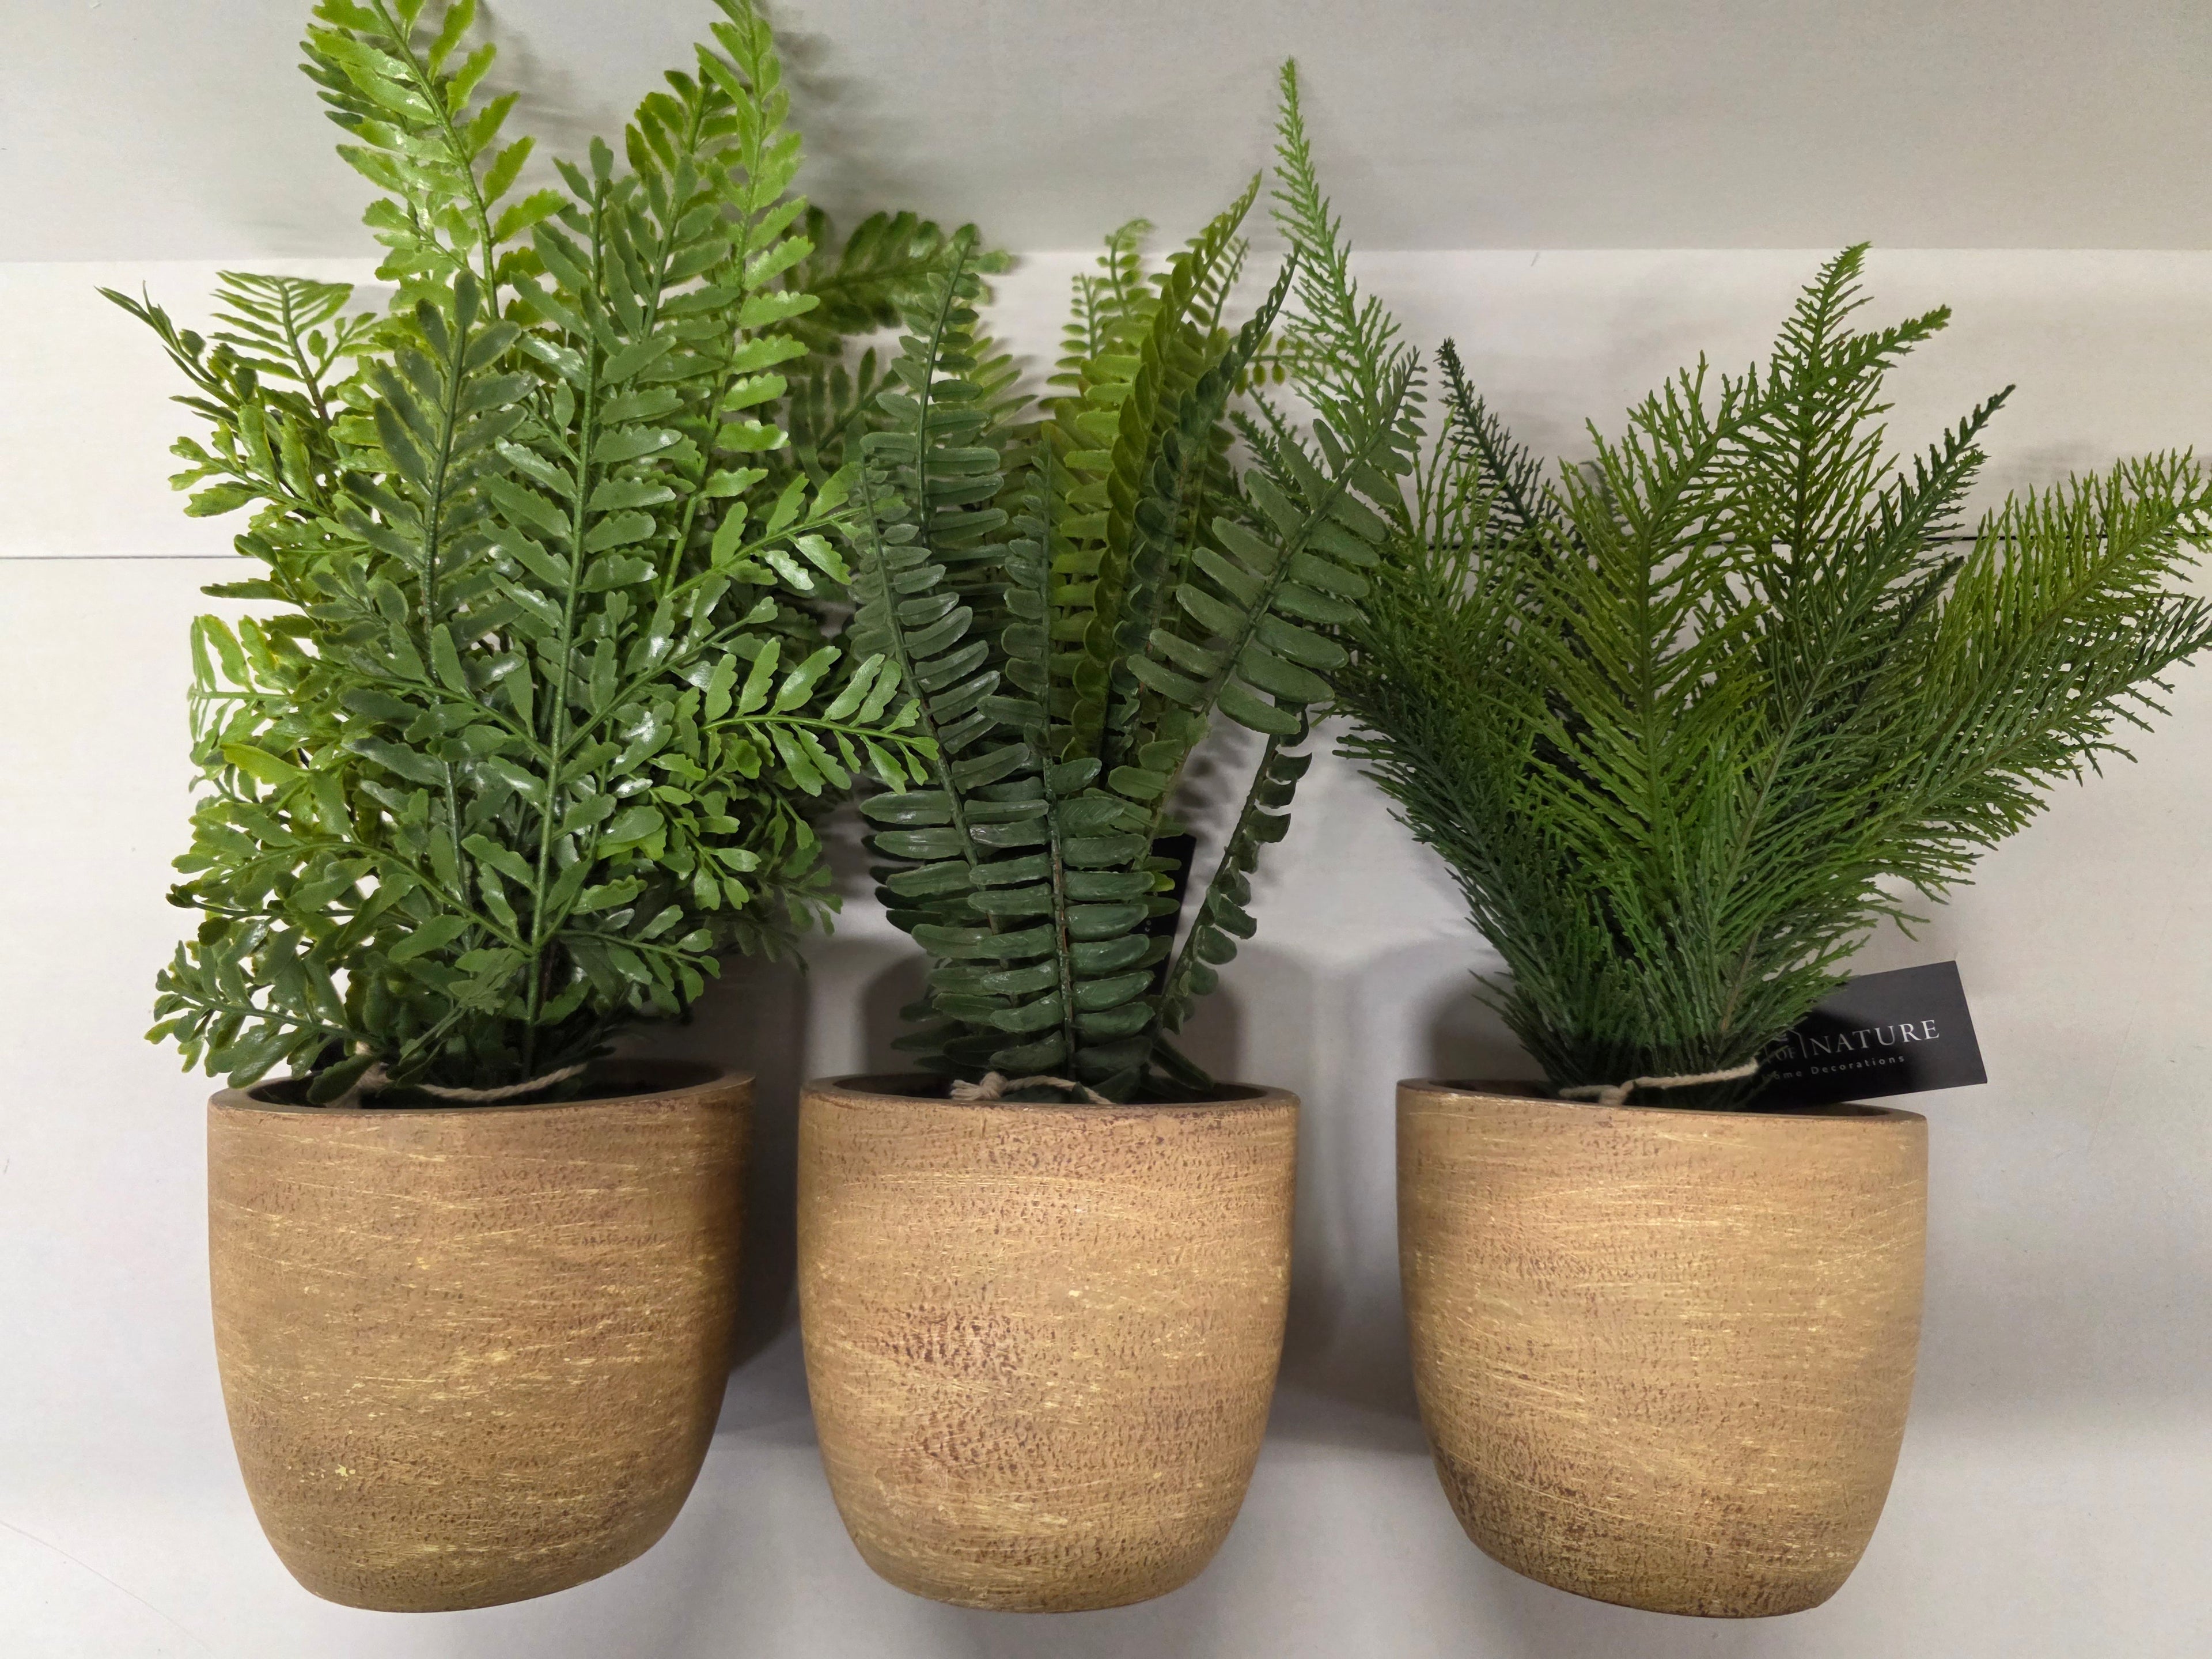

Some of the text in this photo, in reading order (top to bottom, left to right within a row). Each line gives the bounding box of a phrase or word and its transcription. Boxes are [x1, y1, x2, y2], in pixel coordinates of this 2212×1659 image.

[1809, 1019, 1940, 1056] NATURE
[1764, 1055, 1904, 1081] ome Decorations
